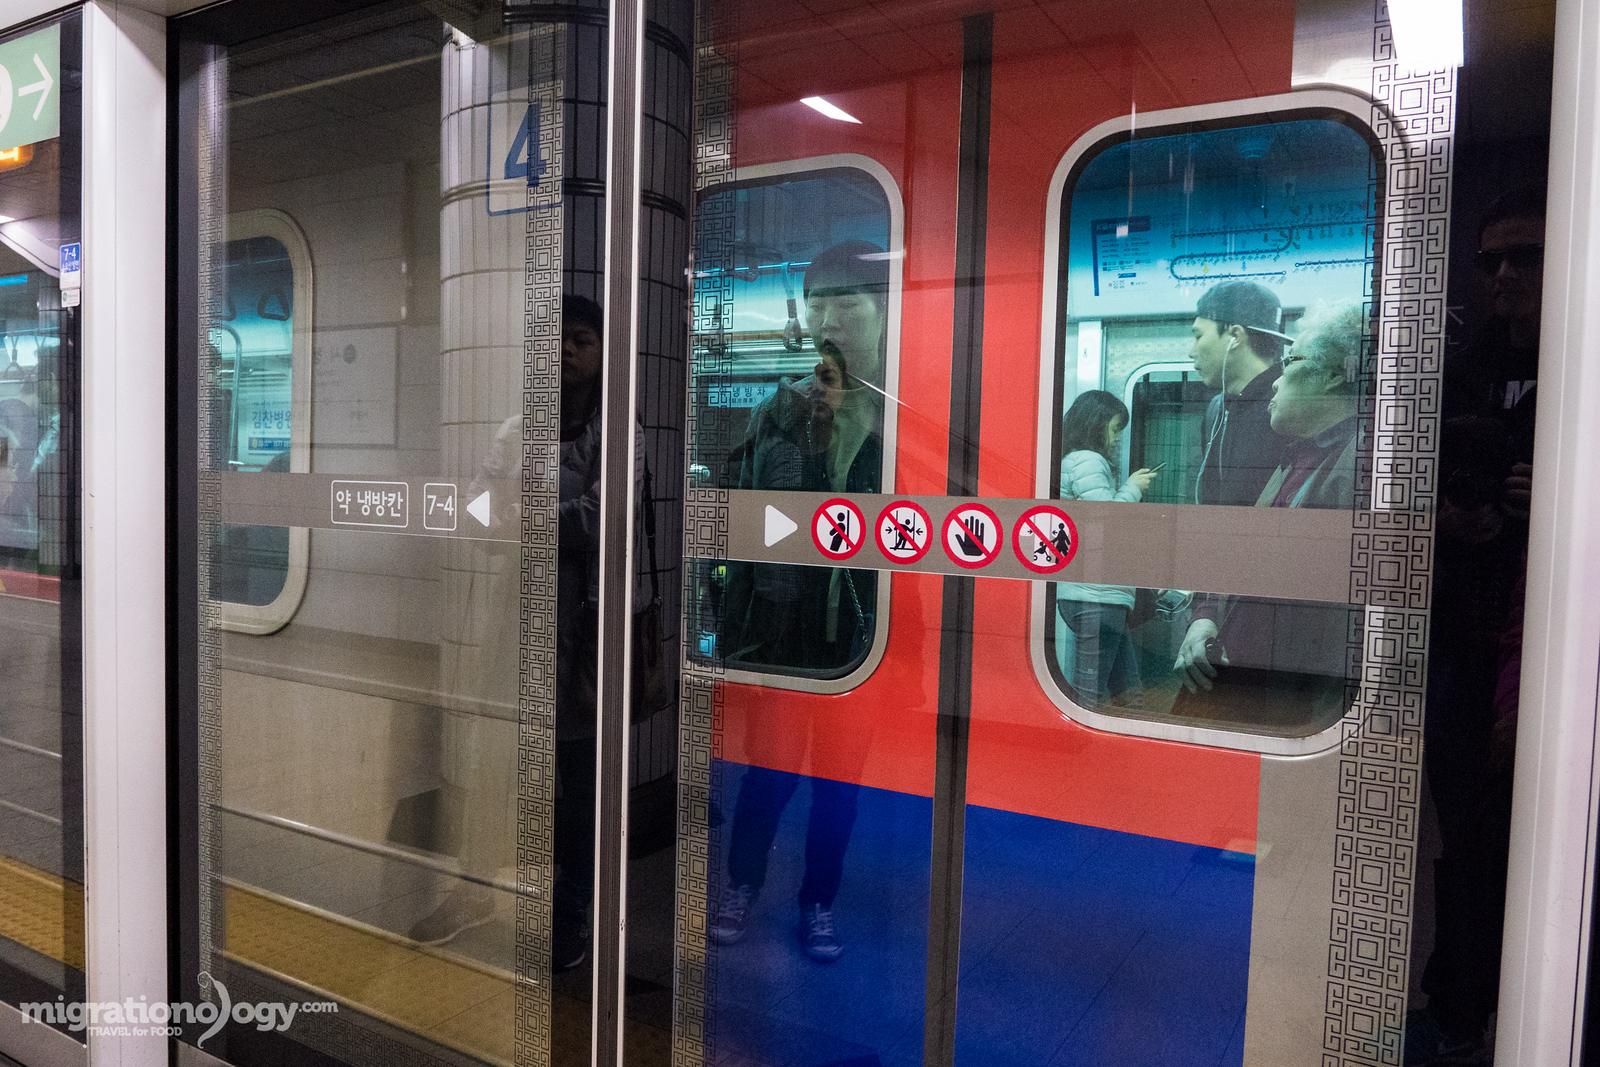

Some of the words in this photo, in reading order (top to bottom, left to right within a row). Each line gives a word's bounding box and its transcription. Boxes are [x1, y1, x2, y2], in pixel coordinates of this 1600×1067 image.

[504, 102, 546, 187] 4
[64, 247, 76, 261] 7-4
[336, 489, 352, 515] 약
[357, 490, 404, 517] 냉방칸
[427, 495, 455, 516] 7-4
